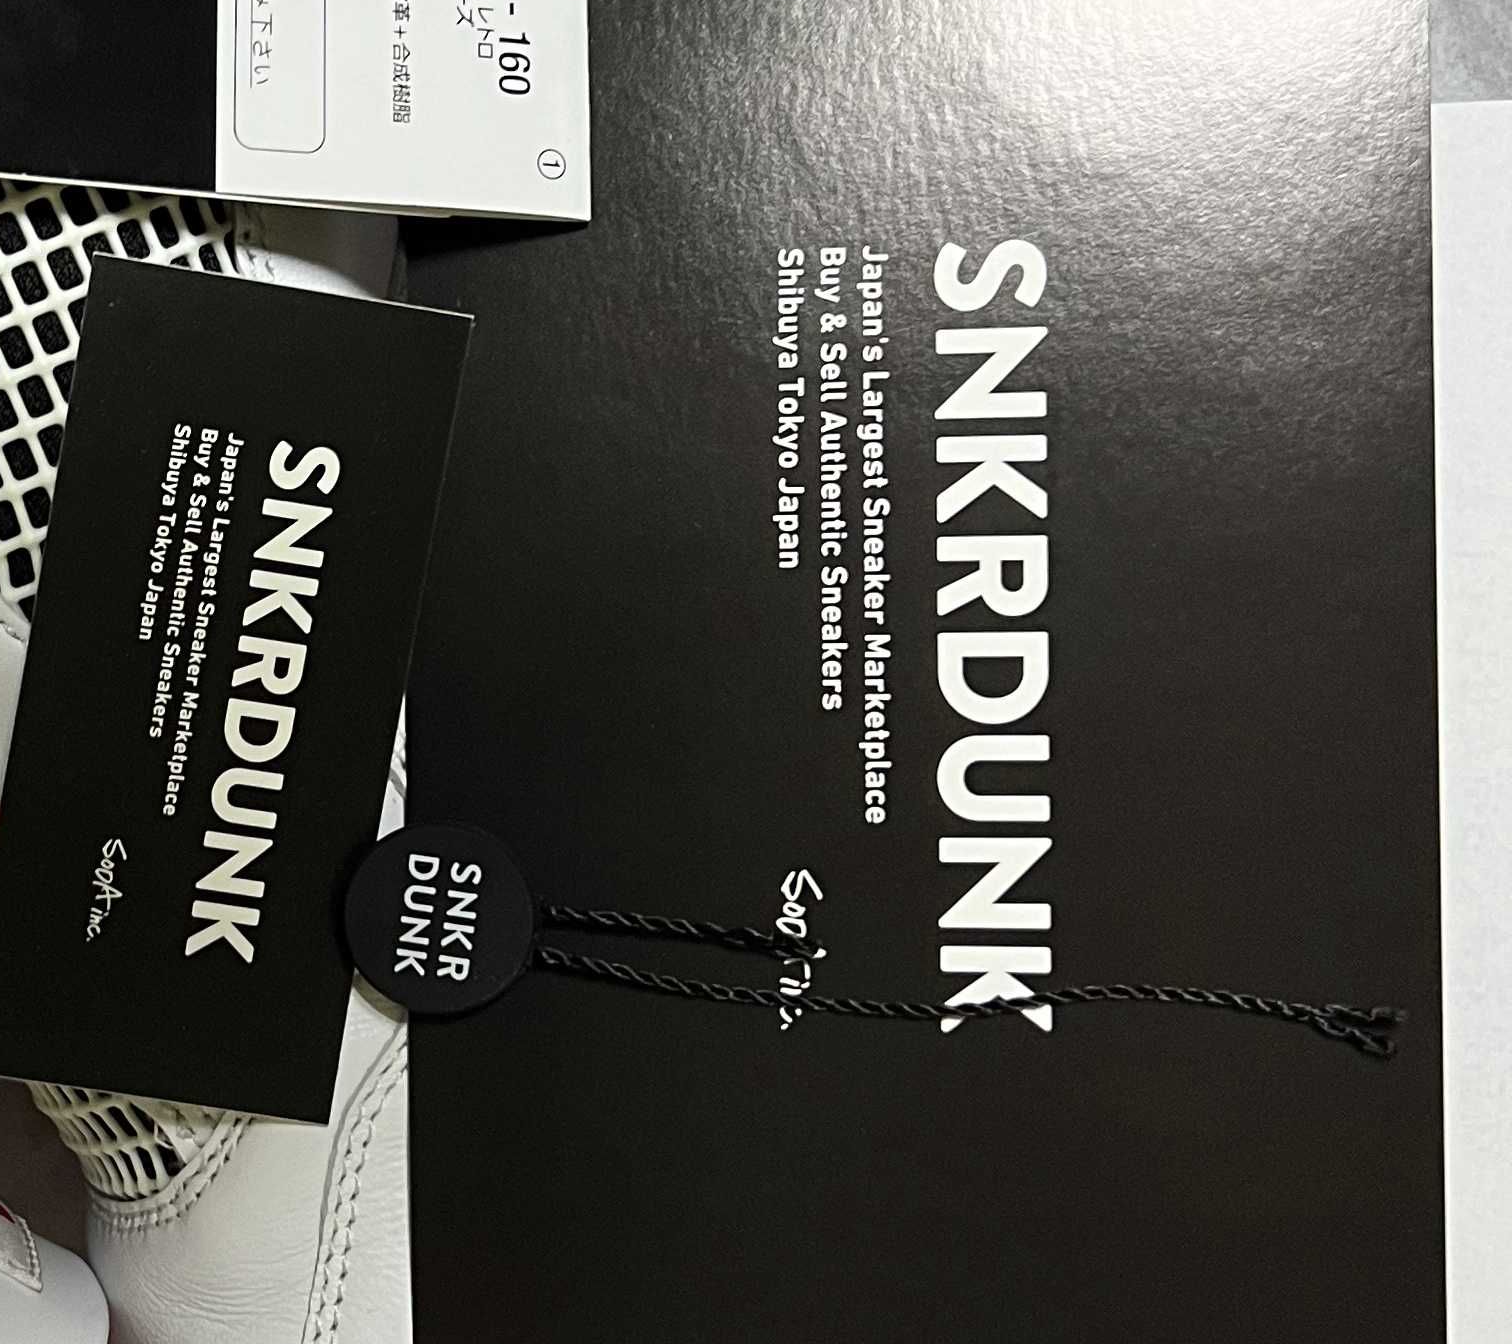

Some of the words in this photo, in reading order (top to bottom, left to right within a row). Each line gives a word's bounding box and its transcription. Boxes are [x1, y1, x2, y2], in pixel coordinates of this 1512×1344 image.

[498, 32, 531, 96] 160
[772, 248, 805, 369] Shibuya
[814, 247, 847, 303] Buy
[856, 245, 889, 362] Japan's
[820, 312, 847, 333] &
[820, 342, 847, 403] Sell
[160, 423, 192, 506] Shibuya
[193, 428, 219, 468] Buy
[772, 377, 805, 469] Tokyo
[856, 371, 890, 489] Largest
[184, 493, 207, 534] Sell
[192, 472, 211, 487] &
[215, 432, 245, 512] Japan's
[820, 411, 848, 557] Authentic
[149, 512, 177, 574] Tokyo
[200, 517, 231, 596] Largest
[772, 477, 805, 569] Japan
[863, 498, 891, 625] Sneaker
[139, 578, 164, 641] Japan
[166, 538, 199, 637] Authentic
[186, 601, 216, 687] Sneaker
[821, 566, 849, 710] Sneakers
[933, 239, 1052, 1032] SNKRDUNK
[149, 642, 181, 738] Sneakers
[184, 440, 341, 964] SNKRDUNK
[858, 634, 892, 824] Marketplace
[162, 691, 200, 816] Marketplace
[394, 853, 440, 976] DUNK
[436, 862, 482, 981] SNKR
